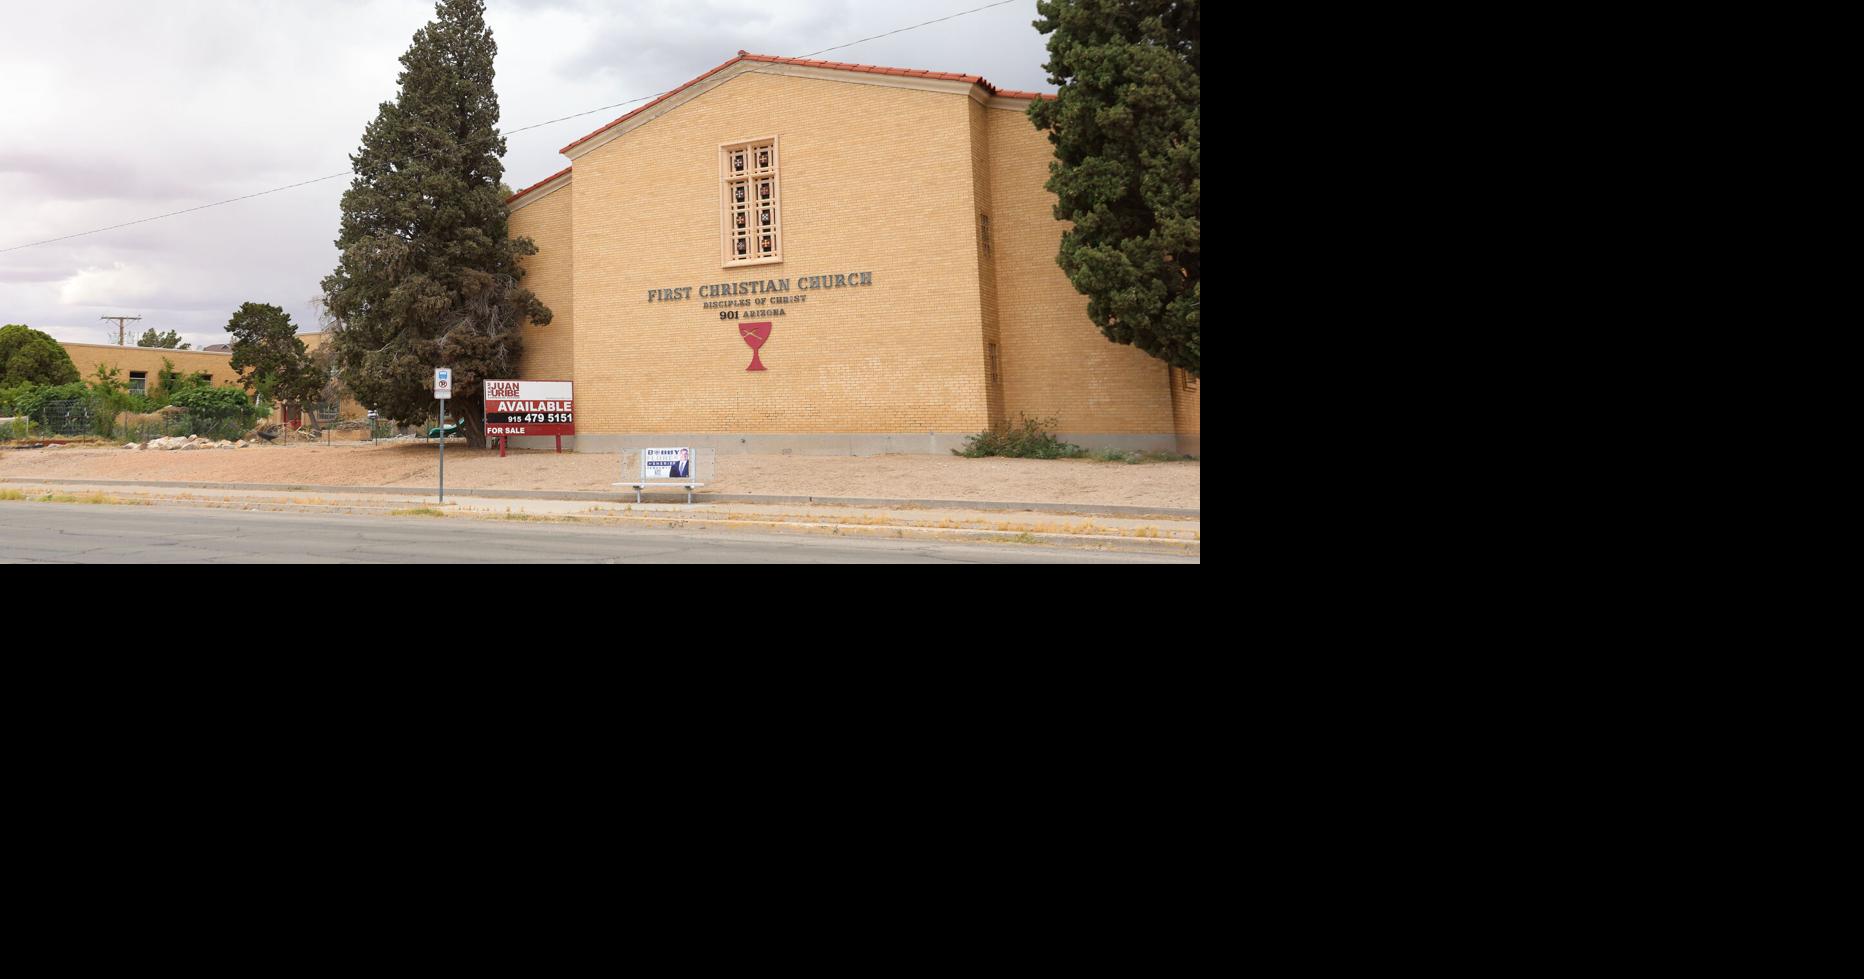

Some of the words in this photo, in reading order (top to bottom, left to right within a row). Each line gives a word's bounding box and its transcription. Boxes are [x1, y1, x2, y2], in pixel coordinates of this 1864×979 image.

[648, 286, 692, 303] FIRST
[699, 278, 790, 298] CHRISTIAN
[797, 271, 873, 290] CHURCH
[703, 298, 751, 310] DISCIPLES
[754, 297, 767, 305] OF
[769, 294, 807, 304] CHRIST
[719, 310, 739, 321] 901
[742, 308, 786, 318] ARIZONA
[491, 382, 520, 390] JUAN
[491, 389, 520, 397] URIBE
[497, 401, 572, 412] AVAILABLE
[524, 413, 545, 423] 479
[547, 413, 573, 423] 5151
